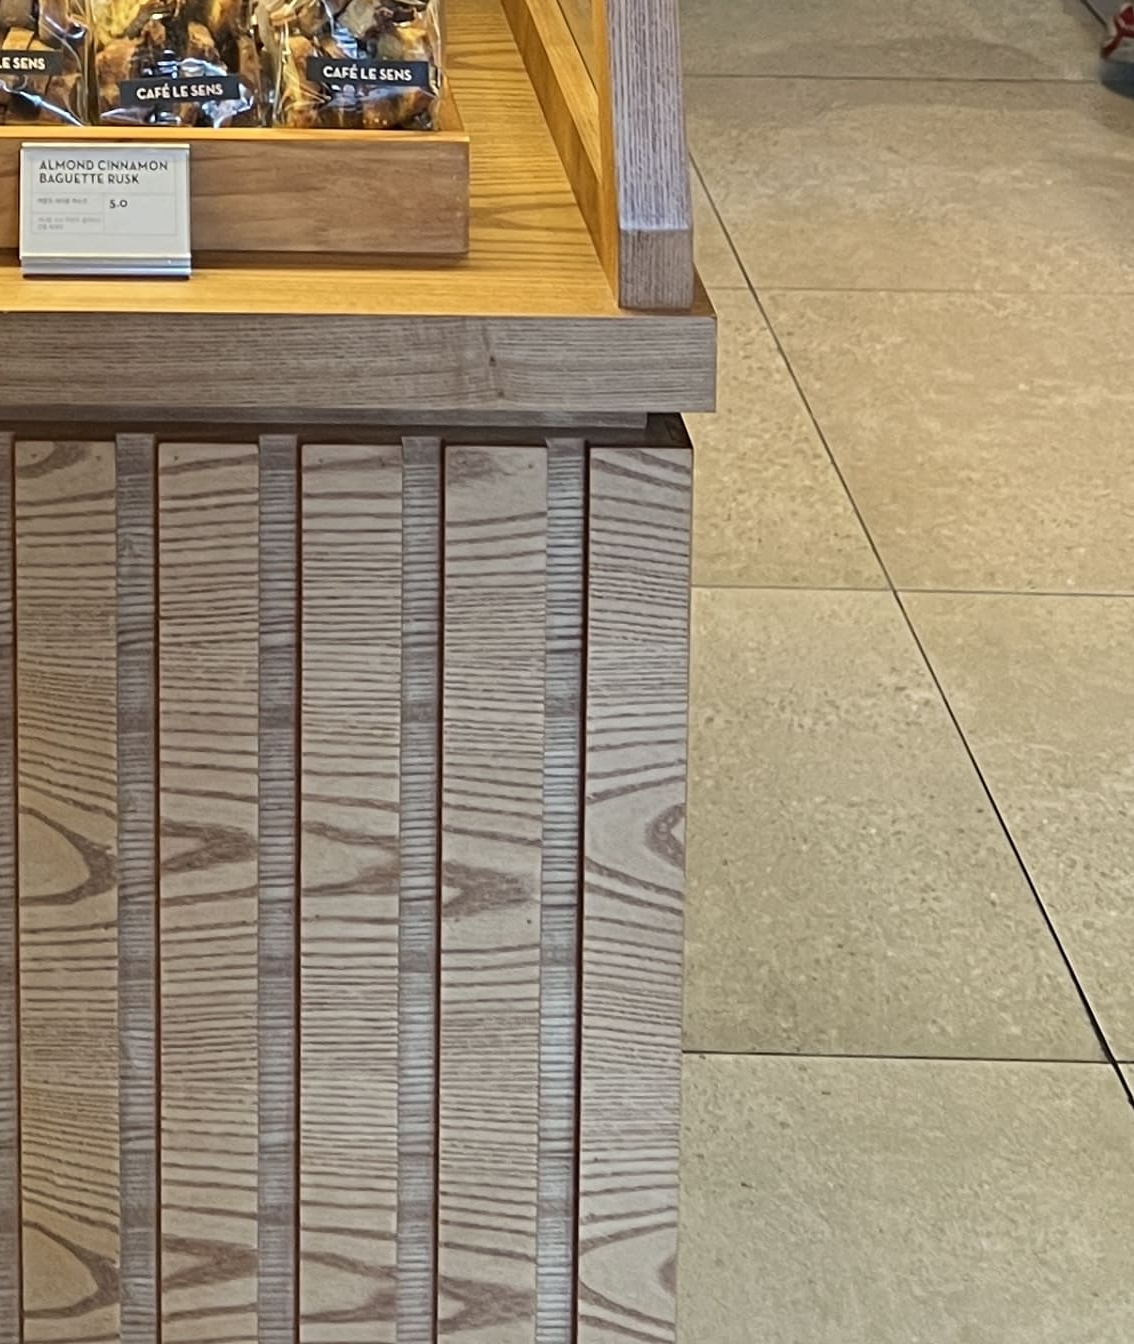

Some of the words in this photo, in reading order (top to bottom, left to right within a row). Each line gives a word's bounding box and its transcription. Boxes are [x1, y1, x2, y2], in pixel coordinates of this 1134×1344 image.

[12, 57, 46, 70] SENS
[323, 64, 358, 79] CAFÉ
[360, 67, 377, 80] LE
[379, 68, 412, 81] SENS
[136, 83, 170, 100] CAFÉ
[172, 85, 189, 98] LE
[190, 83, 224, 97] SENS
[39, 160, 94, 171] ALMOND
[97, 160, 168, 171] CINNAMON
[39, 173, 104, 184] BAGUETTE
[108, 173, 140, 184] RUSK
[109, 199, 128, 209] 5.0
